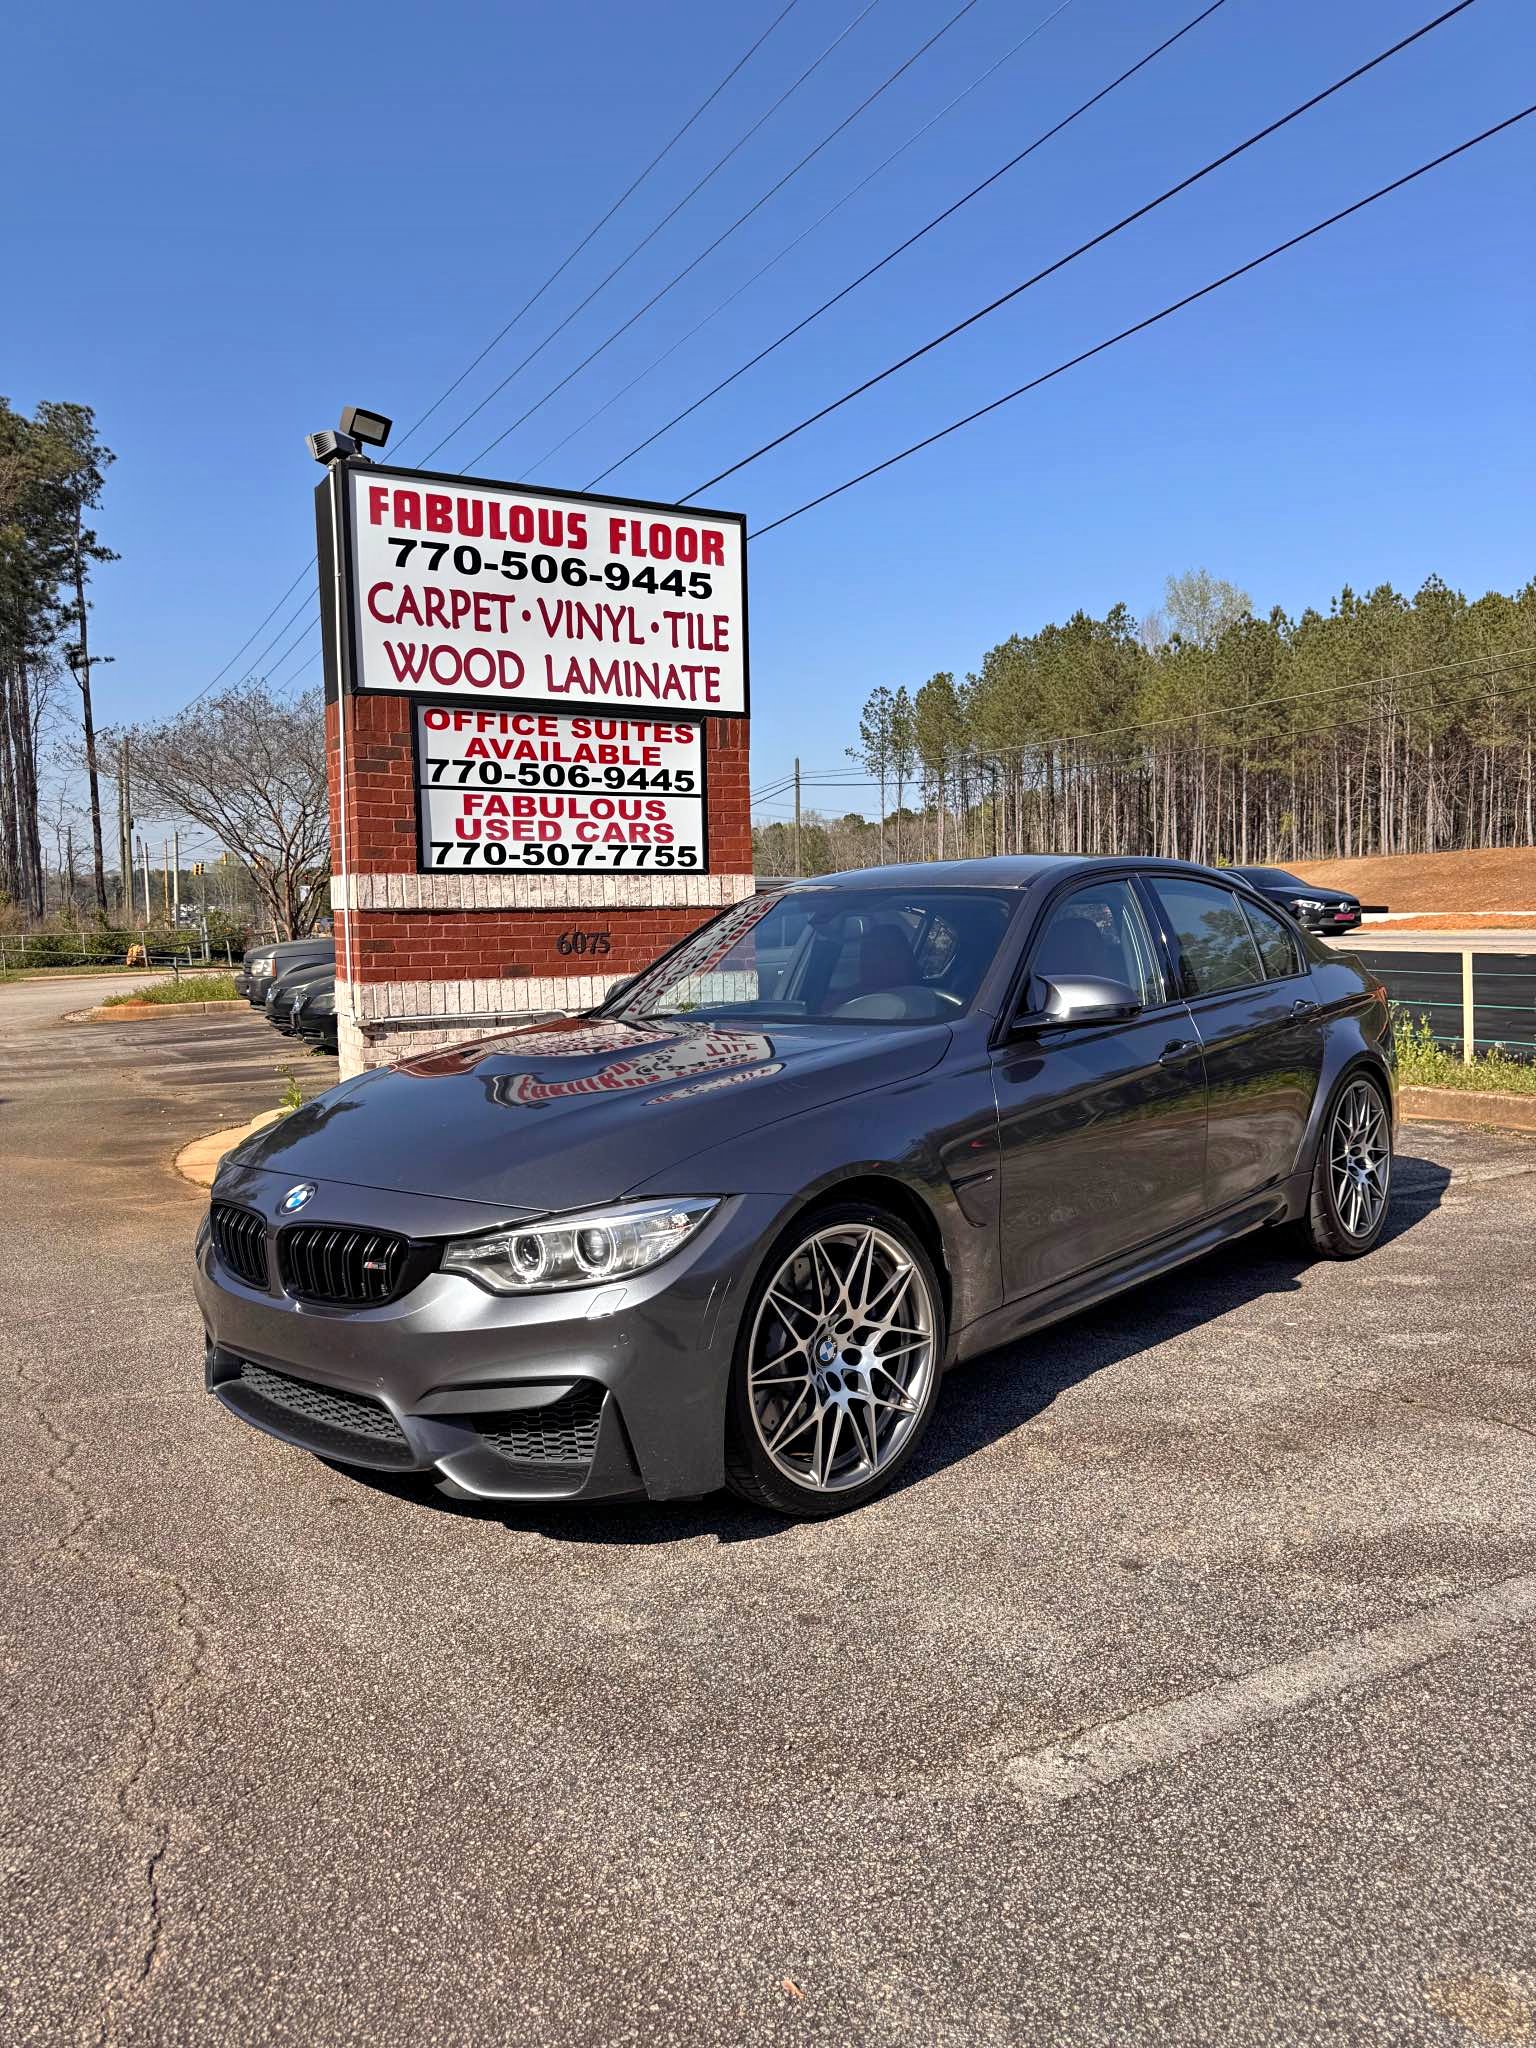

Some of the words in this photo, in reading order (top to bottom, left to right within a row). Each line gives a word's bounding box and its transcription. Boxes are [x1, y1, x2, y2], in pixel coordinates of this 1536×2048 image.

[369, 486, 588, 551] FABULOUS
[609, 517, 725, 567] FLOOR
[387, 537, 713, 600] 770-506-9445
[368, 581, 515, 633] CARPET
[536, 597, 645, 645] VINYL
[664, 611, 729, 652] TILE
[383, 640, 525, 689] WOOD
[545, 654, 720, 703] LAMINATE
[424, 708, 558, 737] OFFICE
[571, 718, 695, 744] SUITES
[464, 737, 661, 767] AVAILABLE
[425, 758, 695, 793] 770-506-9445
[463, 794, 667, 821] FABULOUS
[455, 818, 562, 842] USED
[576, 821, 675, 844] CARS
[430, 841, 698, 868] 770-507-7755
[556, 931, 611, 956] 6075
